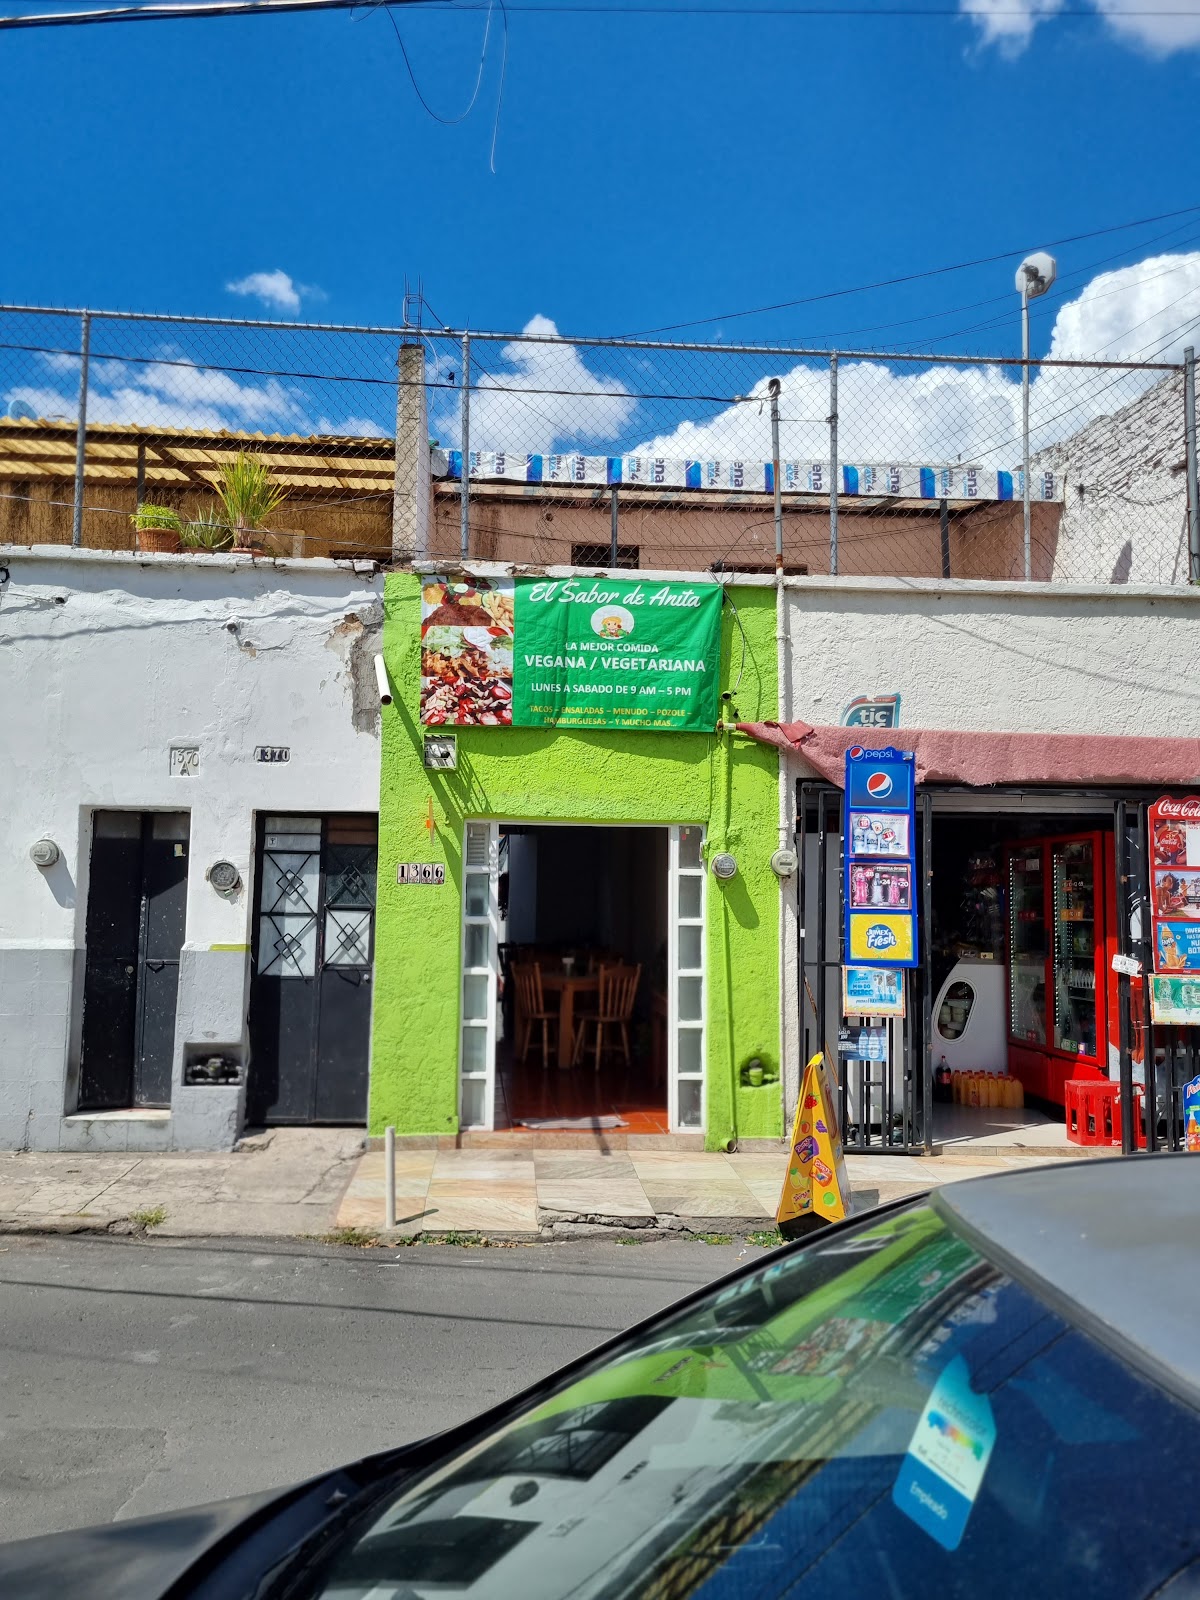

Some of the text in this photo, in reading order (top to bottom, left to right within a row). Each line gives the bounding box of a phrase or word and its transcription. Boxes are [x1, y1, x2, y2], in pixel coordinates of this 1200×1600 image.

[529, 581, 701, 608] El Sabor de Anita
[565, 642, 659, 653] LA MEJOR COMIDA
[524, 655, 706, 673] VEGANA / VEGETARIANA
[531, 683, 562, 693] LUNES
[563, 684, 570, 693] A
[572, 684, 613, 694] SABADO
[615, 685, 628, 694] DE
[630, 685, 637, 695] 9
[639, 686, 656, 695] AM
[666, 686, 673, 696] 5
[675, 687, 692, 696] PM
[529, 705, 553, 713] TACOS
[561, 706, 604, 715] ENSALADAS
[613, 708, 649, 716] MENUDO
[656, 708, 686, 717] POZOLE
[860, 708, 887, 723] tic
[544, 716, 607, 725] HAMBURGUESAS
[621, 718, 651, 727] MUCHO
[171, 749, 199, 767] 1370
[256, 747, 290, 762] 1370
[865, 750, 894, 760] pepsi
[180, 761, 190, 776] A
[1158, 799, 1200, 817] Coca-Col
[398, 864, 444, 879] 1366
[866, 928, 889, 936] JUMEX
[868, 932, 896, 948] Fresh
[909, 1481, 949, 1520] Empleado
